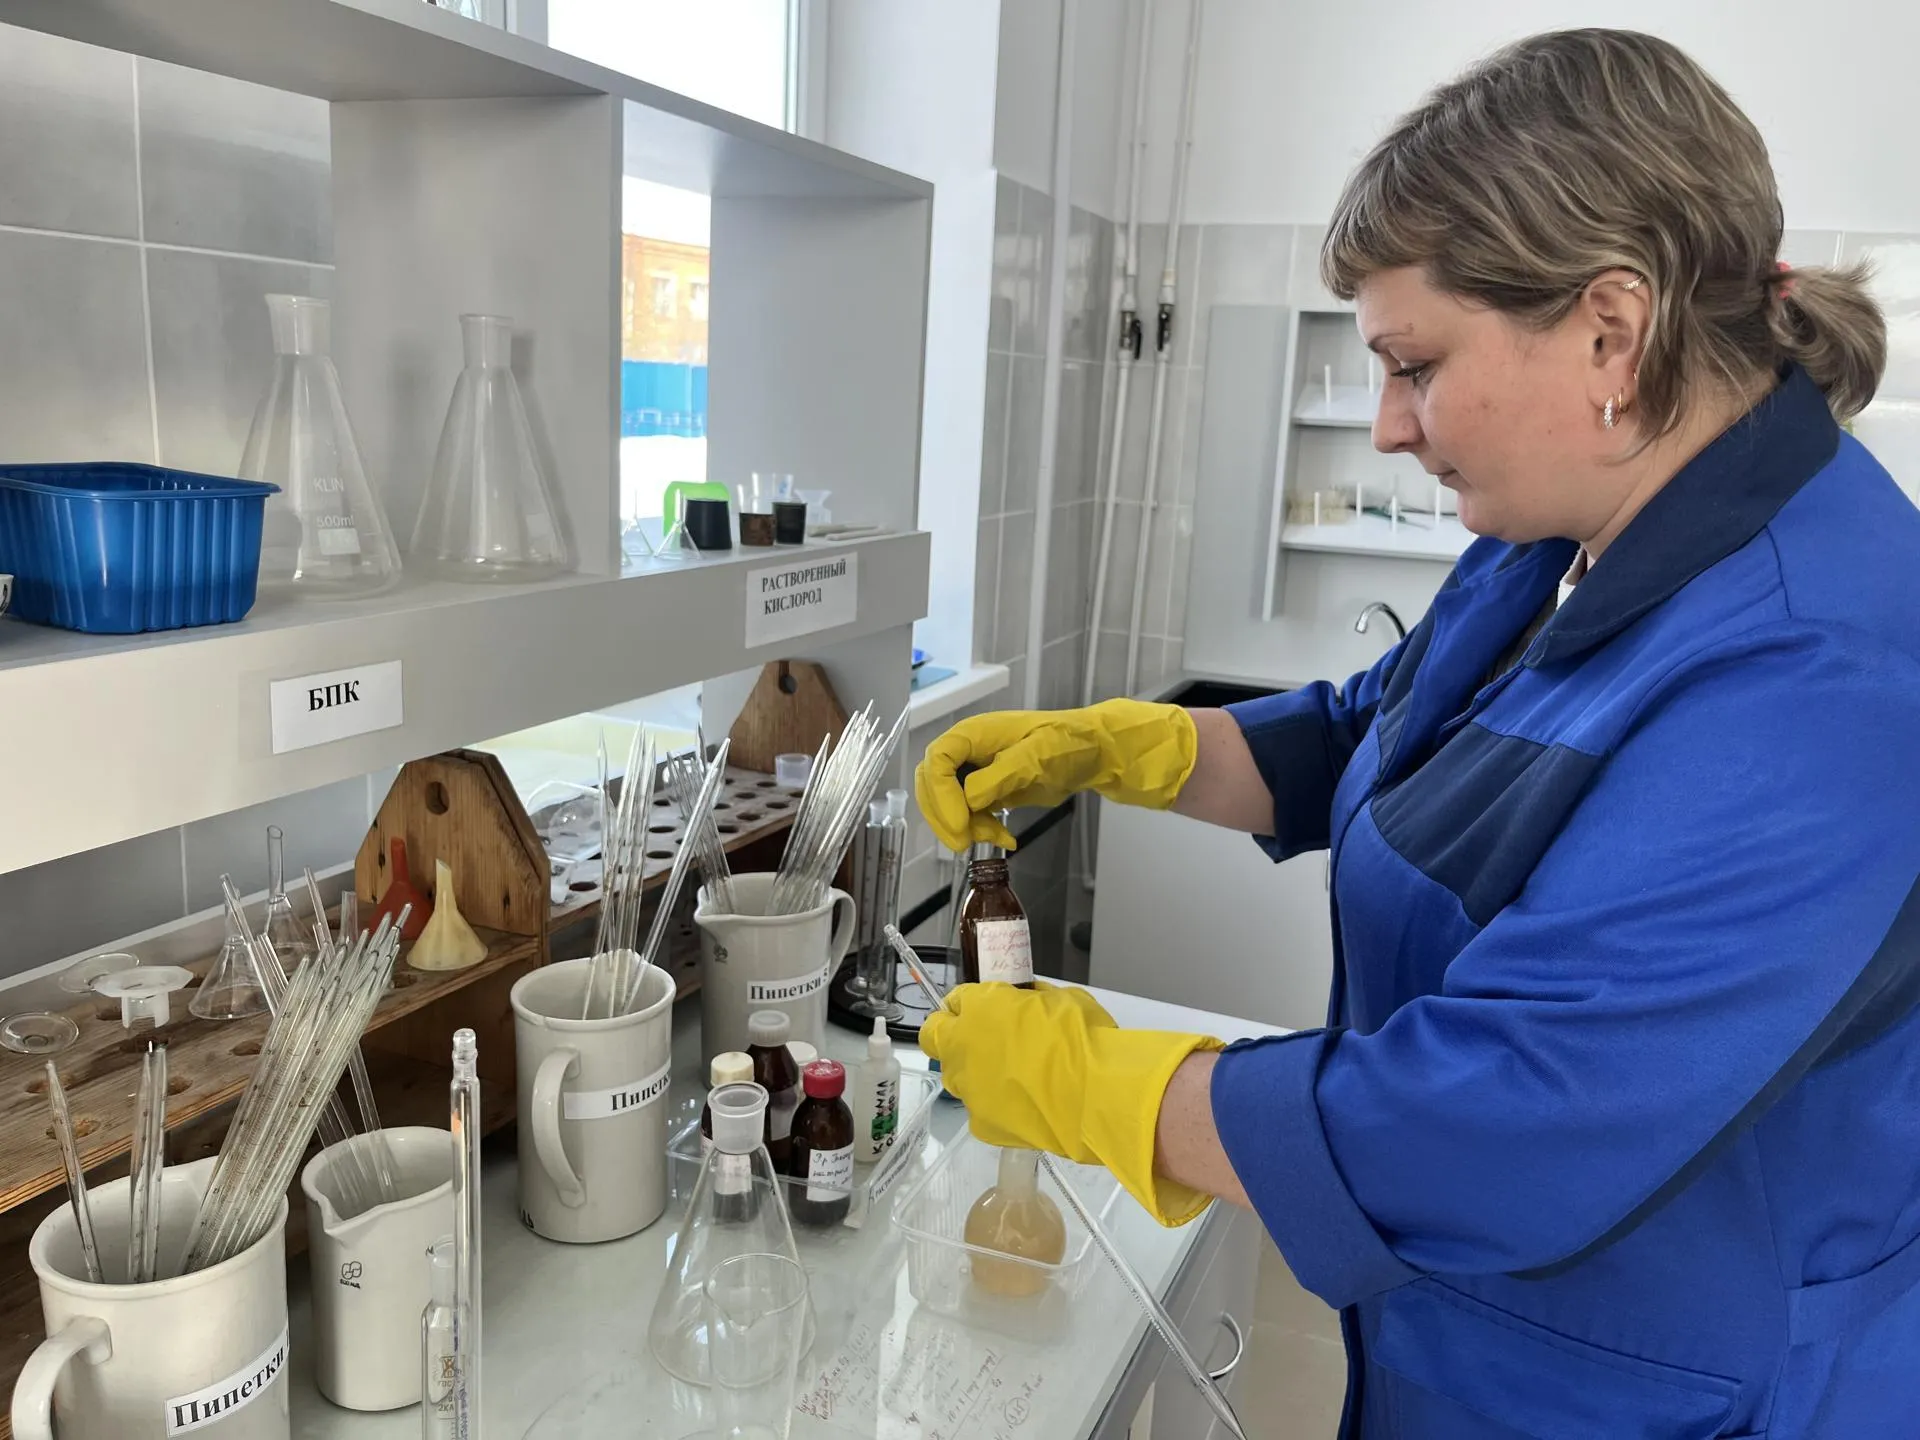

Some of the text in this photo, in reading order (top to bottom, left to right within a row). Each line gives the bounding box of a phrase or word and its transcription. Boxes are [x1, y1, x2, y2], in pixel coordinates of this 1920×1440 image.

[313, 476, 344, 493] KLIN
[762, 558, 847, 593] РАСТВОРЕННЫЙ
[764, 587, 822, 615] КИСЛОРОД
[307, 680, 360, 712] БПК
[750, 976, 821, 1000] Пипетки
[611, 1072, 670, 1111] Пипетк
[172, 1346, 284, 1428] Пипетки
